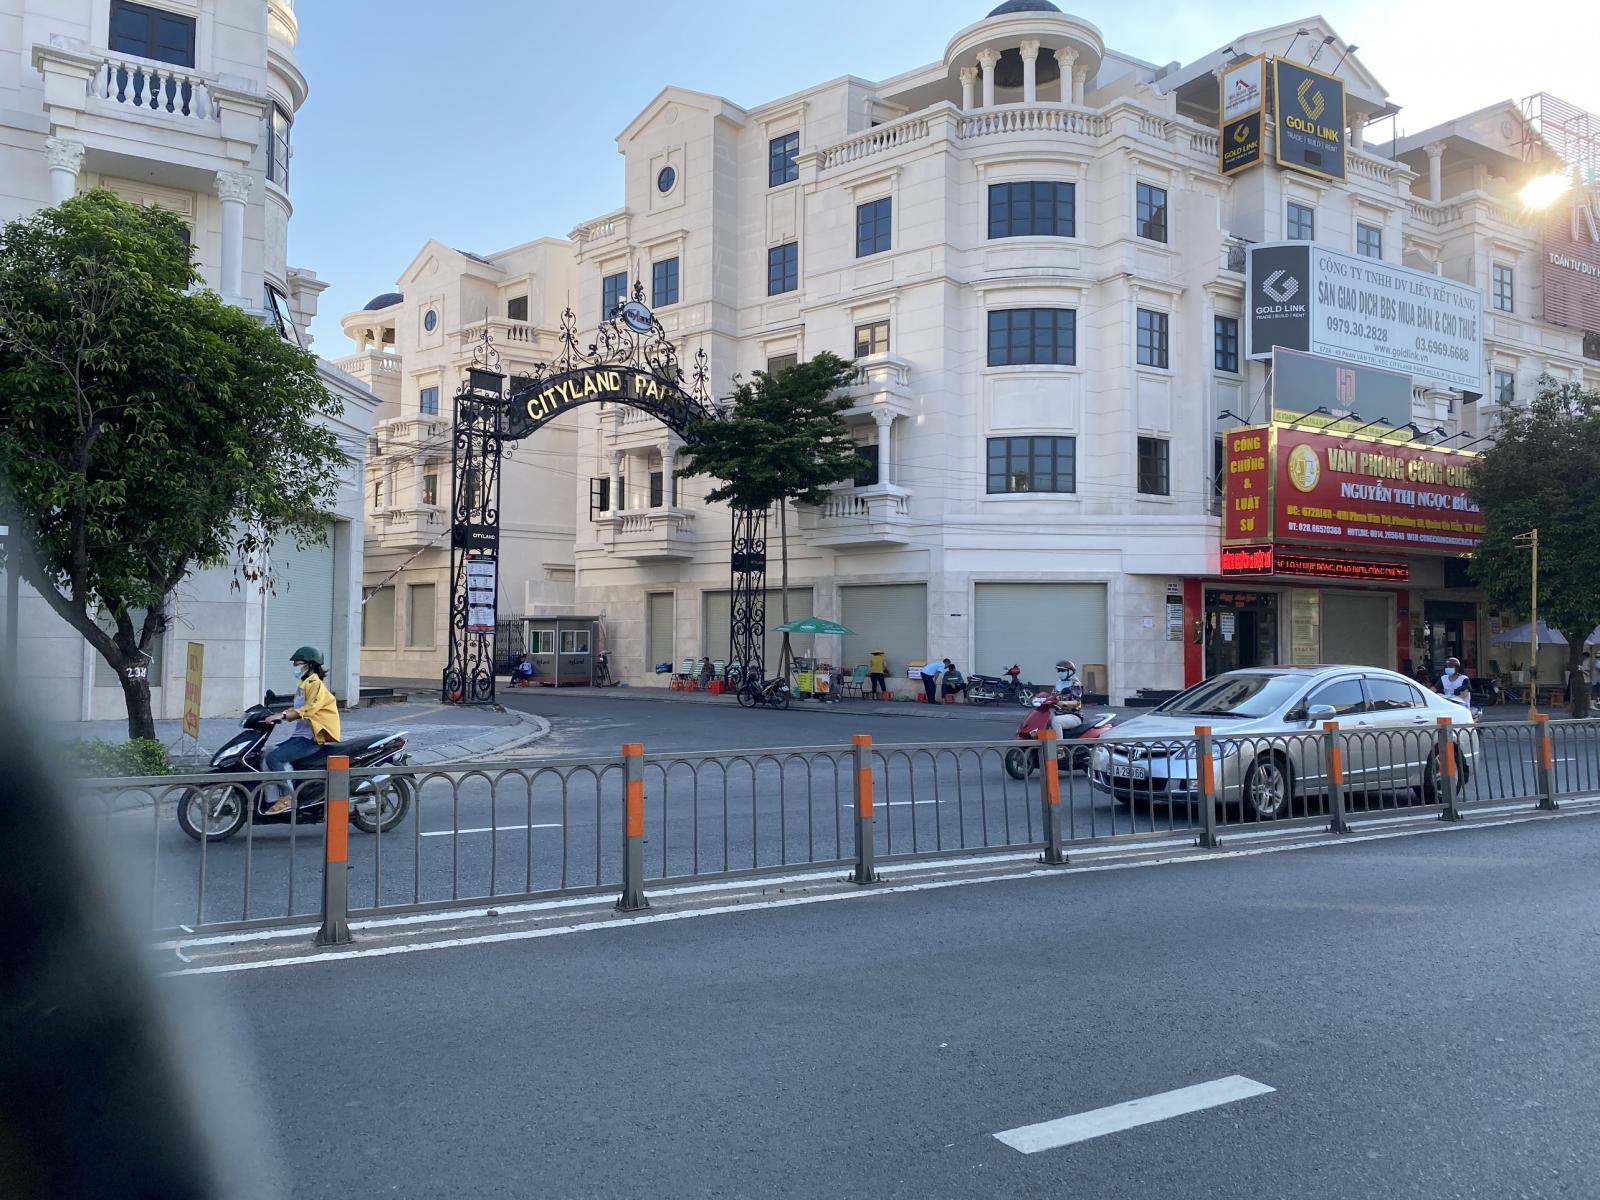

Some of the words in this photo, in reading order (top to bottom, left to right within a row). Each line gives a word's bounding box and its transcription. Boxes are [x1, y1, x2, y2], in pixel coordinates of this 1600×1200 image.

[1286, 115, 1315, 134] GOLD
[1317, 125, 1339, 142] LINK
[1225, 147, 1241, 159] GOLD
[1243, 140, 1258, 152] LINK
[1549, 253, 1570, 268] TOÁN
[1581, 263, 1597, 276] DUY
[1319, 256, 1348, 277] CÔNG
[1350, 265, 1364, 281] TY
[1365, 270, 1392, 288] TNHH
[1394, 277, 1407, 292] DV
[1410, 281, 1432, 299] LIÊN
[1433, 285, 1451, 304] KẾT
[1255, 305, 1282, 314] GOLD
[1284, 304, 1306, 312] LINK
[1318, 275, 1336, 307] SÀN
[1338, 285, 1357, 312] GIAO
[1360, 291, 1378, 320] DỊCH
[1380, 295, 1397, 322] BĐS
[1399, 300, 1415, 326] MUA
[1417, 301, 1433, 330] BÁN
[1434, 310, 1441, 332] &
[1442, 311, 1457, 336] CHO
[1327, 316, 1388, 342] 0979.30.2828
[1415, 336, 1469, 362] 03.6969.6688
[1374, 343, 1429, 362] www.goldlink.vn
[527, 371, 621, 420] CITYLAND
[1233, 436, 1261, 452] CÔNG
[1230, 456, 1265, 473] CHỨNG
[1360, 450, 1405, 481] PHÒNG
[1408, 456, 1443, 485] CÔNG
[1244, 478, 1252, 488] &
[1235, 495, 1260, 512] LUẬT
[1341, 480, 1392, 502] NGUYỄN
[1393, 488, 1415, 508] THỊ
[1418, 492, 1451, 511] NGỌC
[1240, 516, 1255, 531] SƯ
[472, 532, 496, 541] CITYLAND
